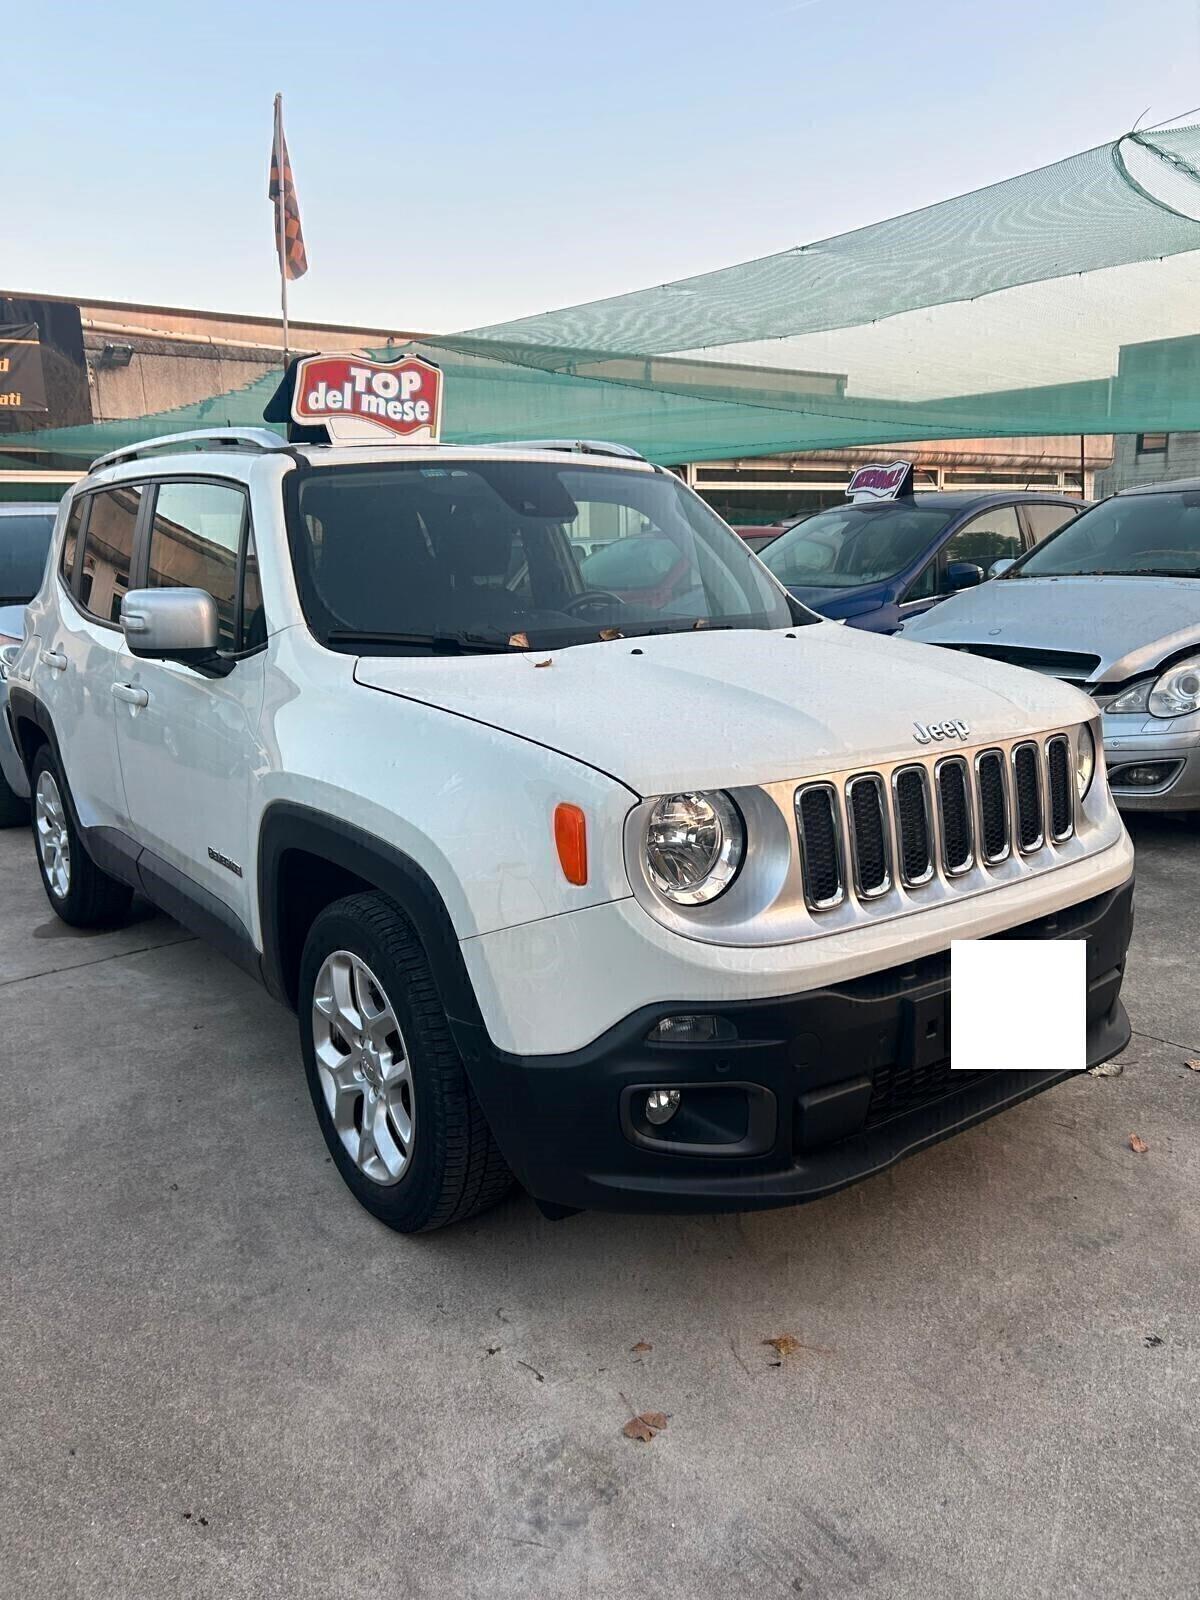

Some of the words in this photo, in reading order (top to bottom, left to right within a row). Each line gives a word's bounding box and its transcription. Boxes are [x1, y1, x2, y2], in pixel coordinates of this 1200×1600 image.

[350, 367, 421, 400] TOP
[308, 382, 352, 410] del
[361, 393, 430, 422] mese
[912, 719, 970, 744] Jeep
